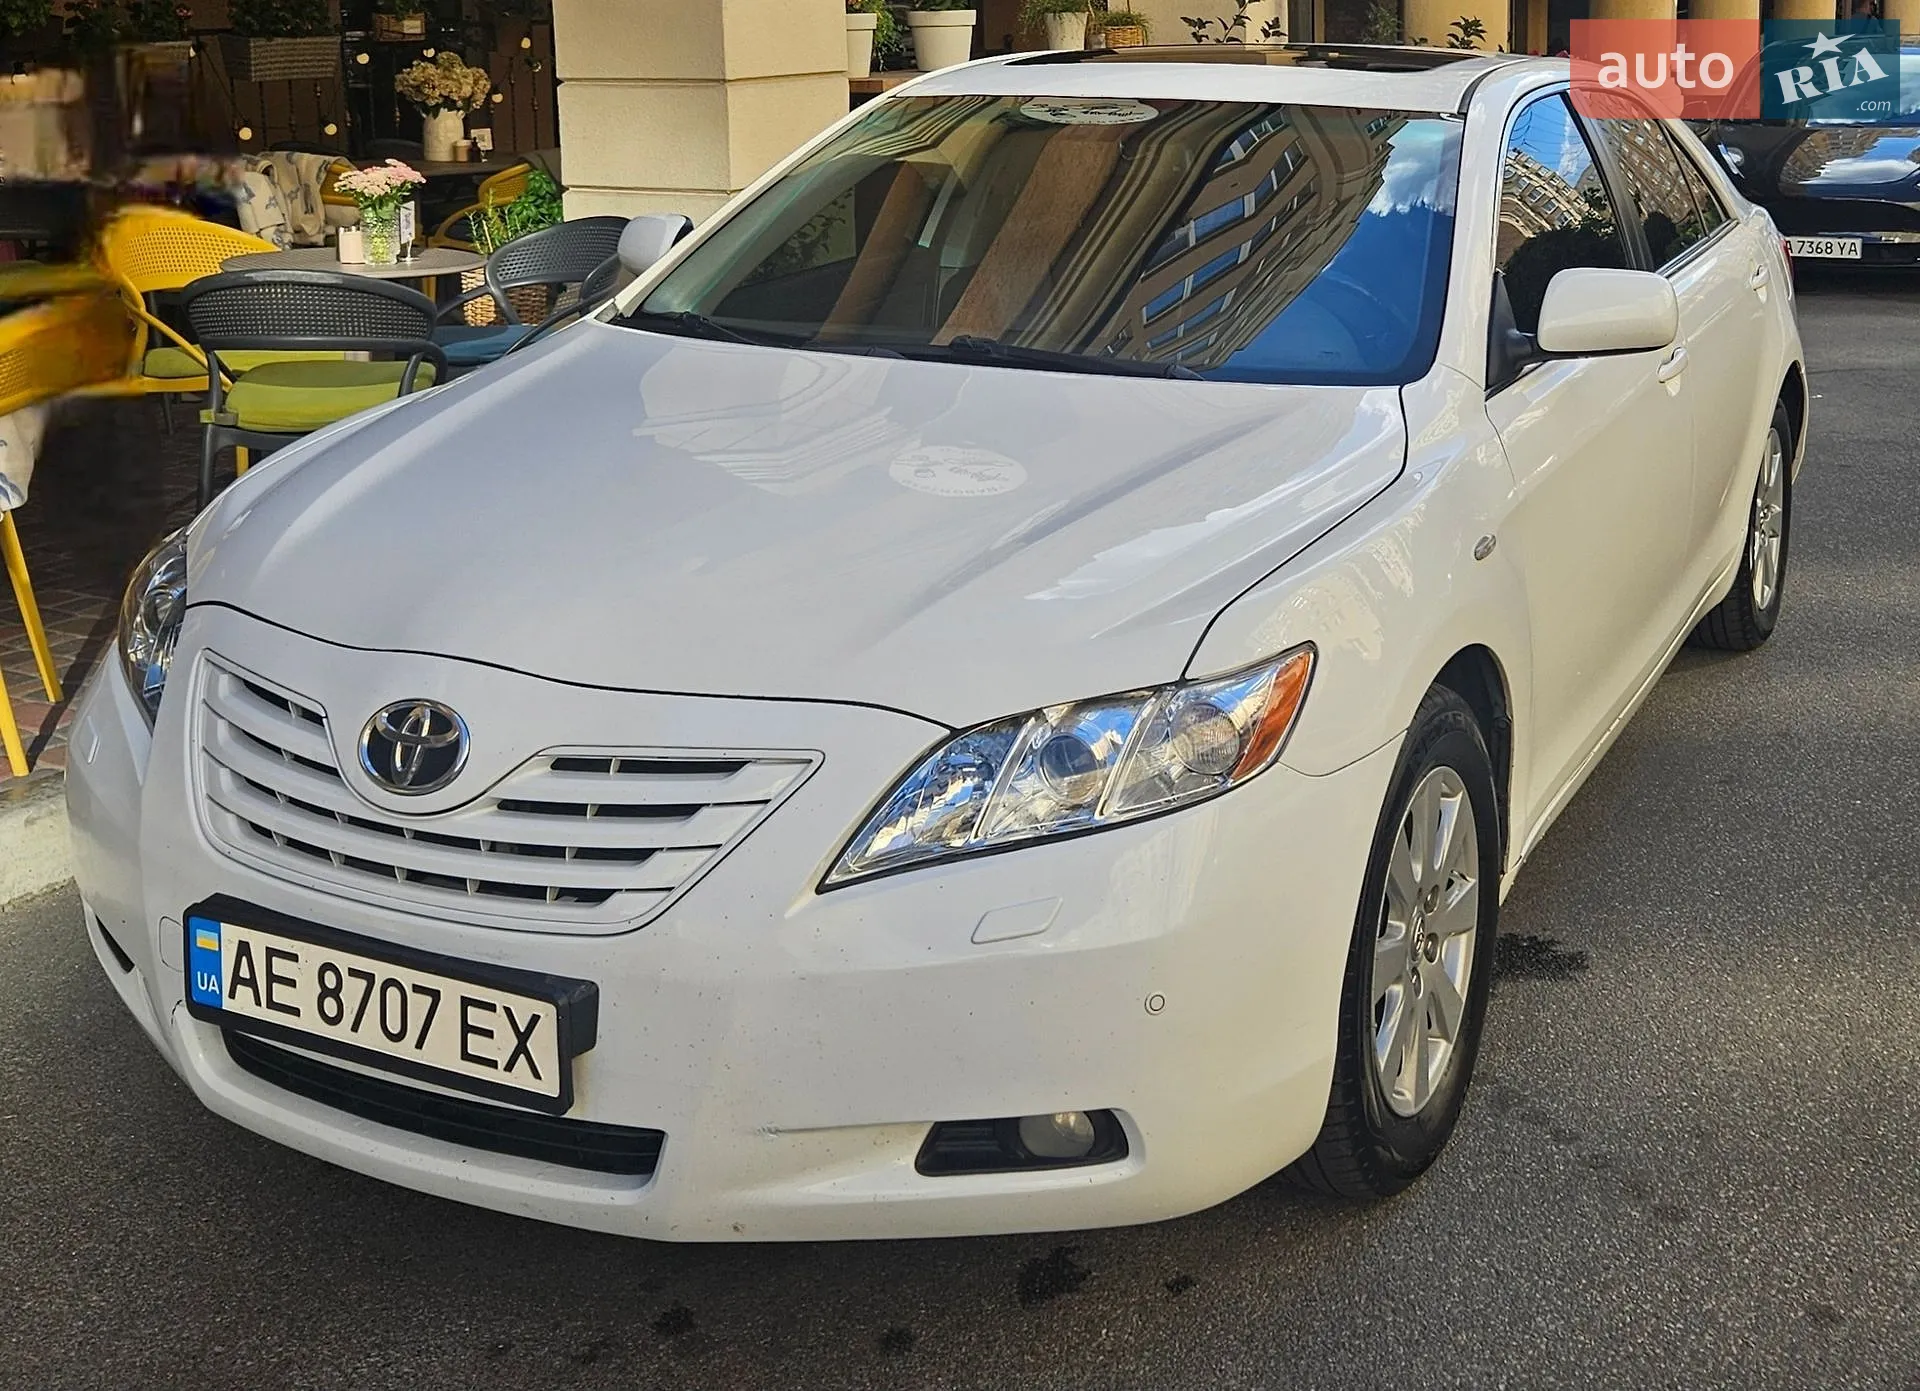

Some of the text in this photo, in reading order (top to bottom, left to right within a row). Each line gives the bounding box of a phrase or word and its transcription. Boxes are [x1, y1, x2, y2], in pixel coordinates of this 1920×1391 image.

[1797, 240, 1834, 255] 7368
[1837, 241, 1858, 256] YA
[197, 971, 220, 995] UA
[228, 940, 543, 1081] AE 8707 EX
